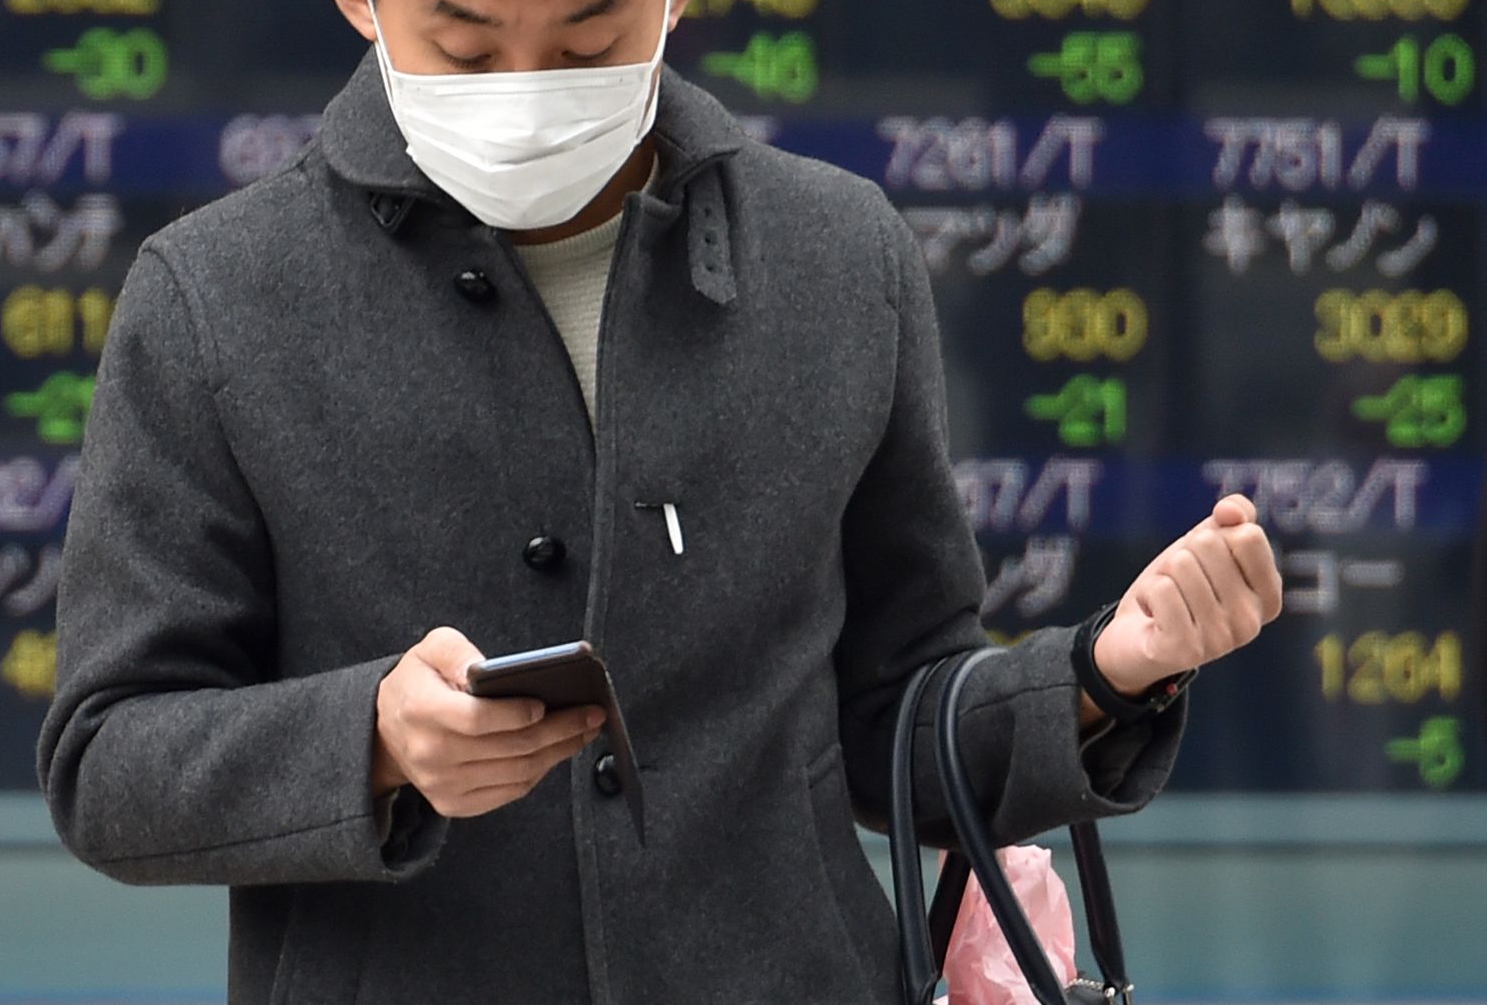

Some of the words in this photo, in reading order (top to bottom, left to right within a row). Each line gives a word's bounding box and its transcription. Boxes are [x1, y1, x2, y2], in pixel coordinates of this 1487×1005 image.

[1358, 35, 1475, 103] -10
[1206, 113, 1425, 189] 7751/T
[1388, 716, 1464, 784] -5
